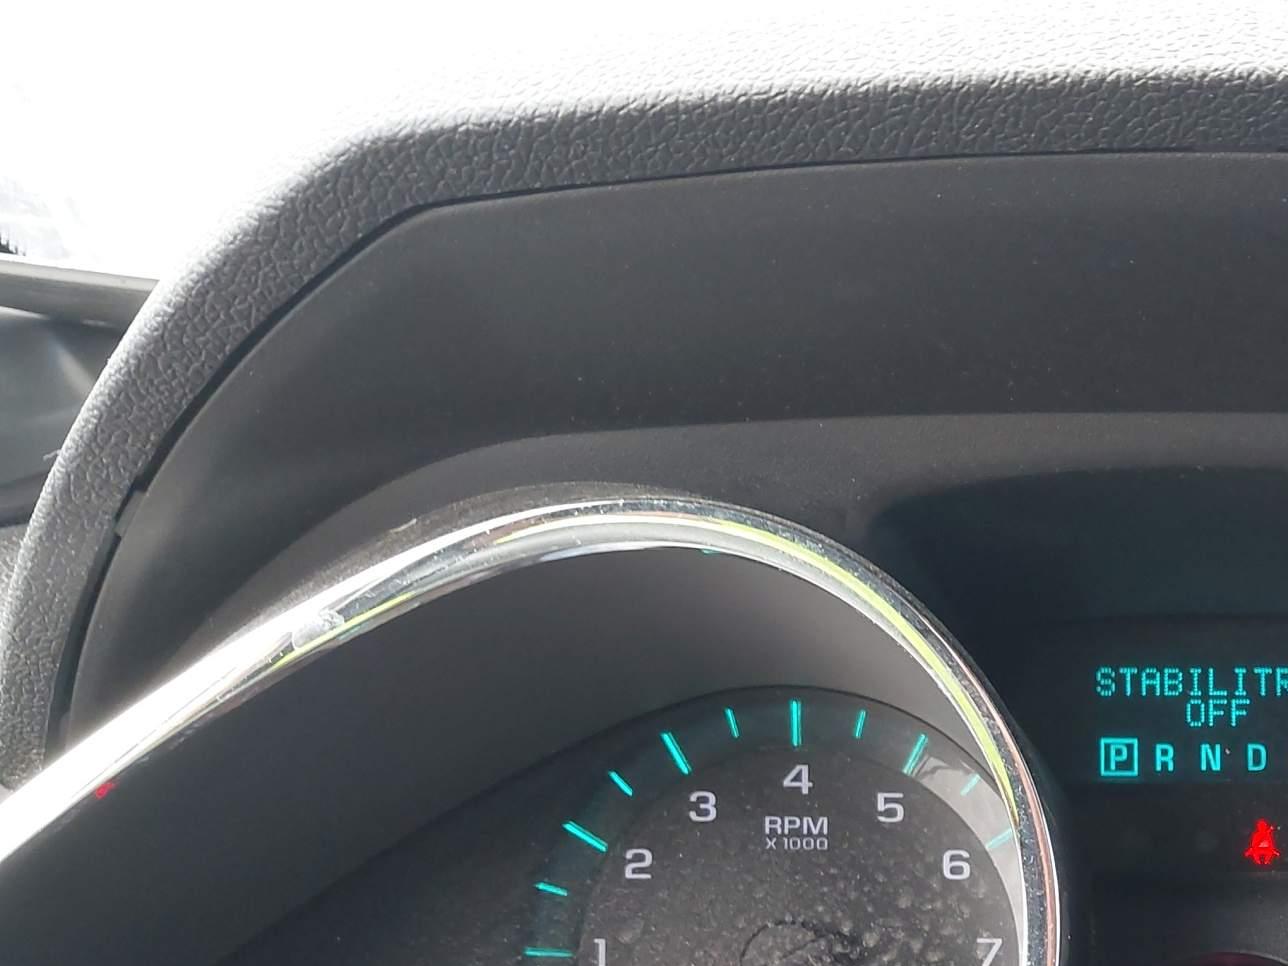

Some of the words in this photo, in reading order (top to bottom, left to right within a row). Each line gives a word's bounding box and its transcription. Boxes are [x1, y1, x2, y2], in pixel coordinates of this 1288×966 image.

[1186, 698, 1250, 727] OFF
[1109, 744, 1127, 771] P
[1155, 744, 1174, 771] R
[1200, 744, 1221, 771] N
[1247, 744, 1267, 771] D
[783, 764, 813, 795] 4
[689, 791, 717, 822] 3
[877, 792, 904, 823] 5
[764, 816, 828, 835] RPM
[782, 837, 828, 850] 1000
[625, 849, 653, 879] 2
[942, 850, 970, 880] 6
